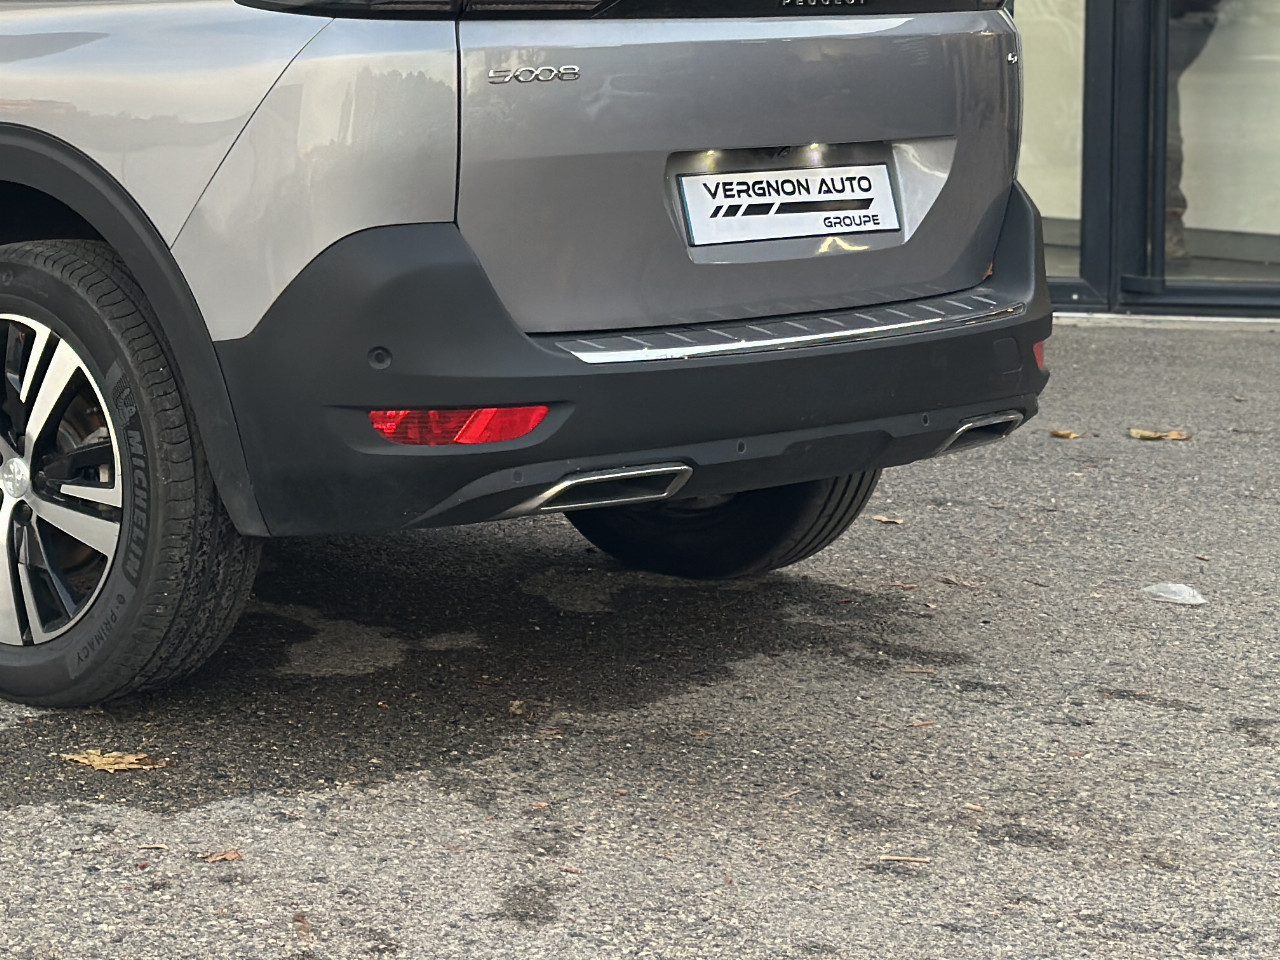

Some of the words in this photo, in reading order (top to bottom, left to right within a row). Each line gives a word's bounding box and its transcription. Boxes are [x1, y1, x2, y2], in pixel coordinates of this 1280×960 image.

[488, 65, 581, 84] 5008
[702, 178, 811, 200] VERGNON
[817, 176, 873, 195] AUTO
[823, 214, 881, 228] GROUPE
[124, 429, 150, 579] MICHELIN
